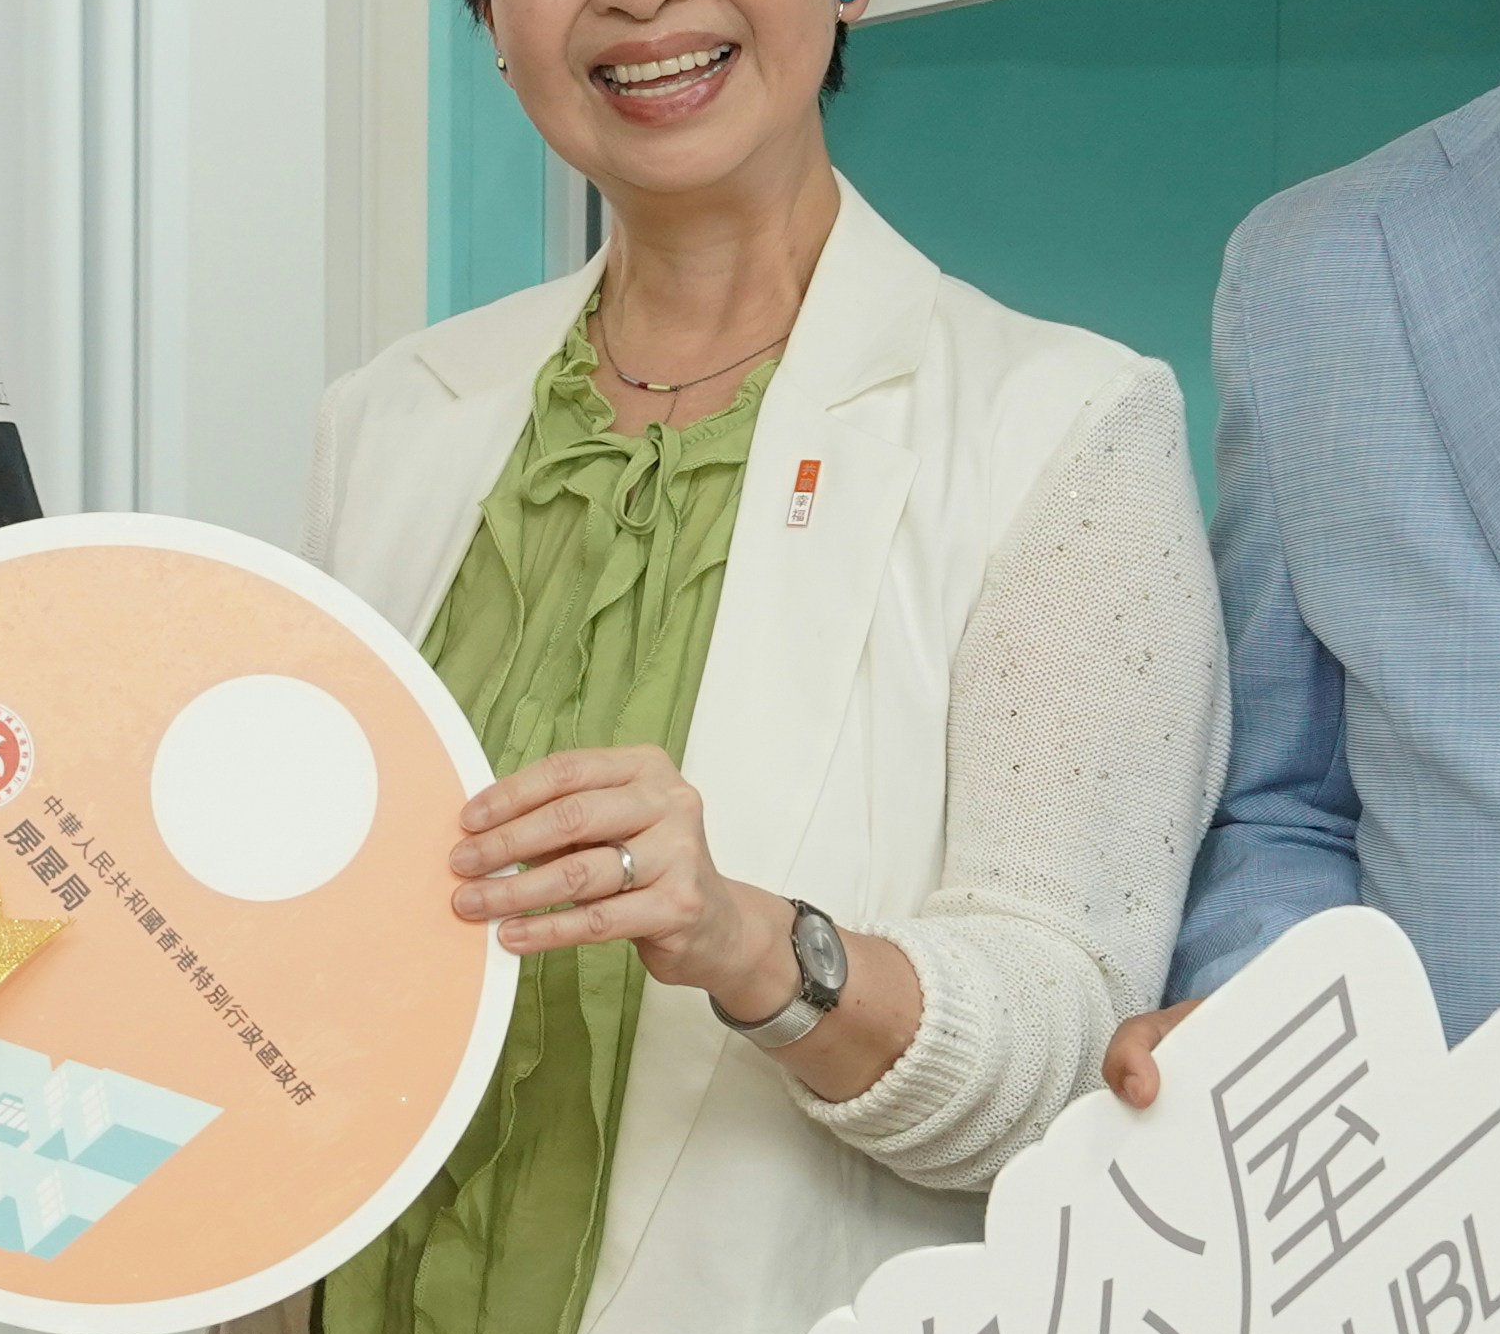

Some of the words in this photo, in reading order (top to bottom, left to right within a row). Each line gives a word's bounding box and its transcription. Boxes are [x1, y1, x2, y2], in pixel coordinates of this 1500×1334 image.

[3, 818, 92, 913] 房屋局
[43, 794, 317, 1106] 中華人民共和國香港特別行政區政府
